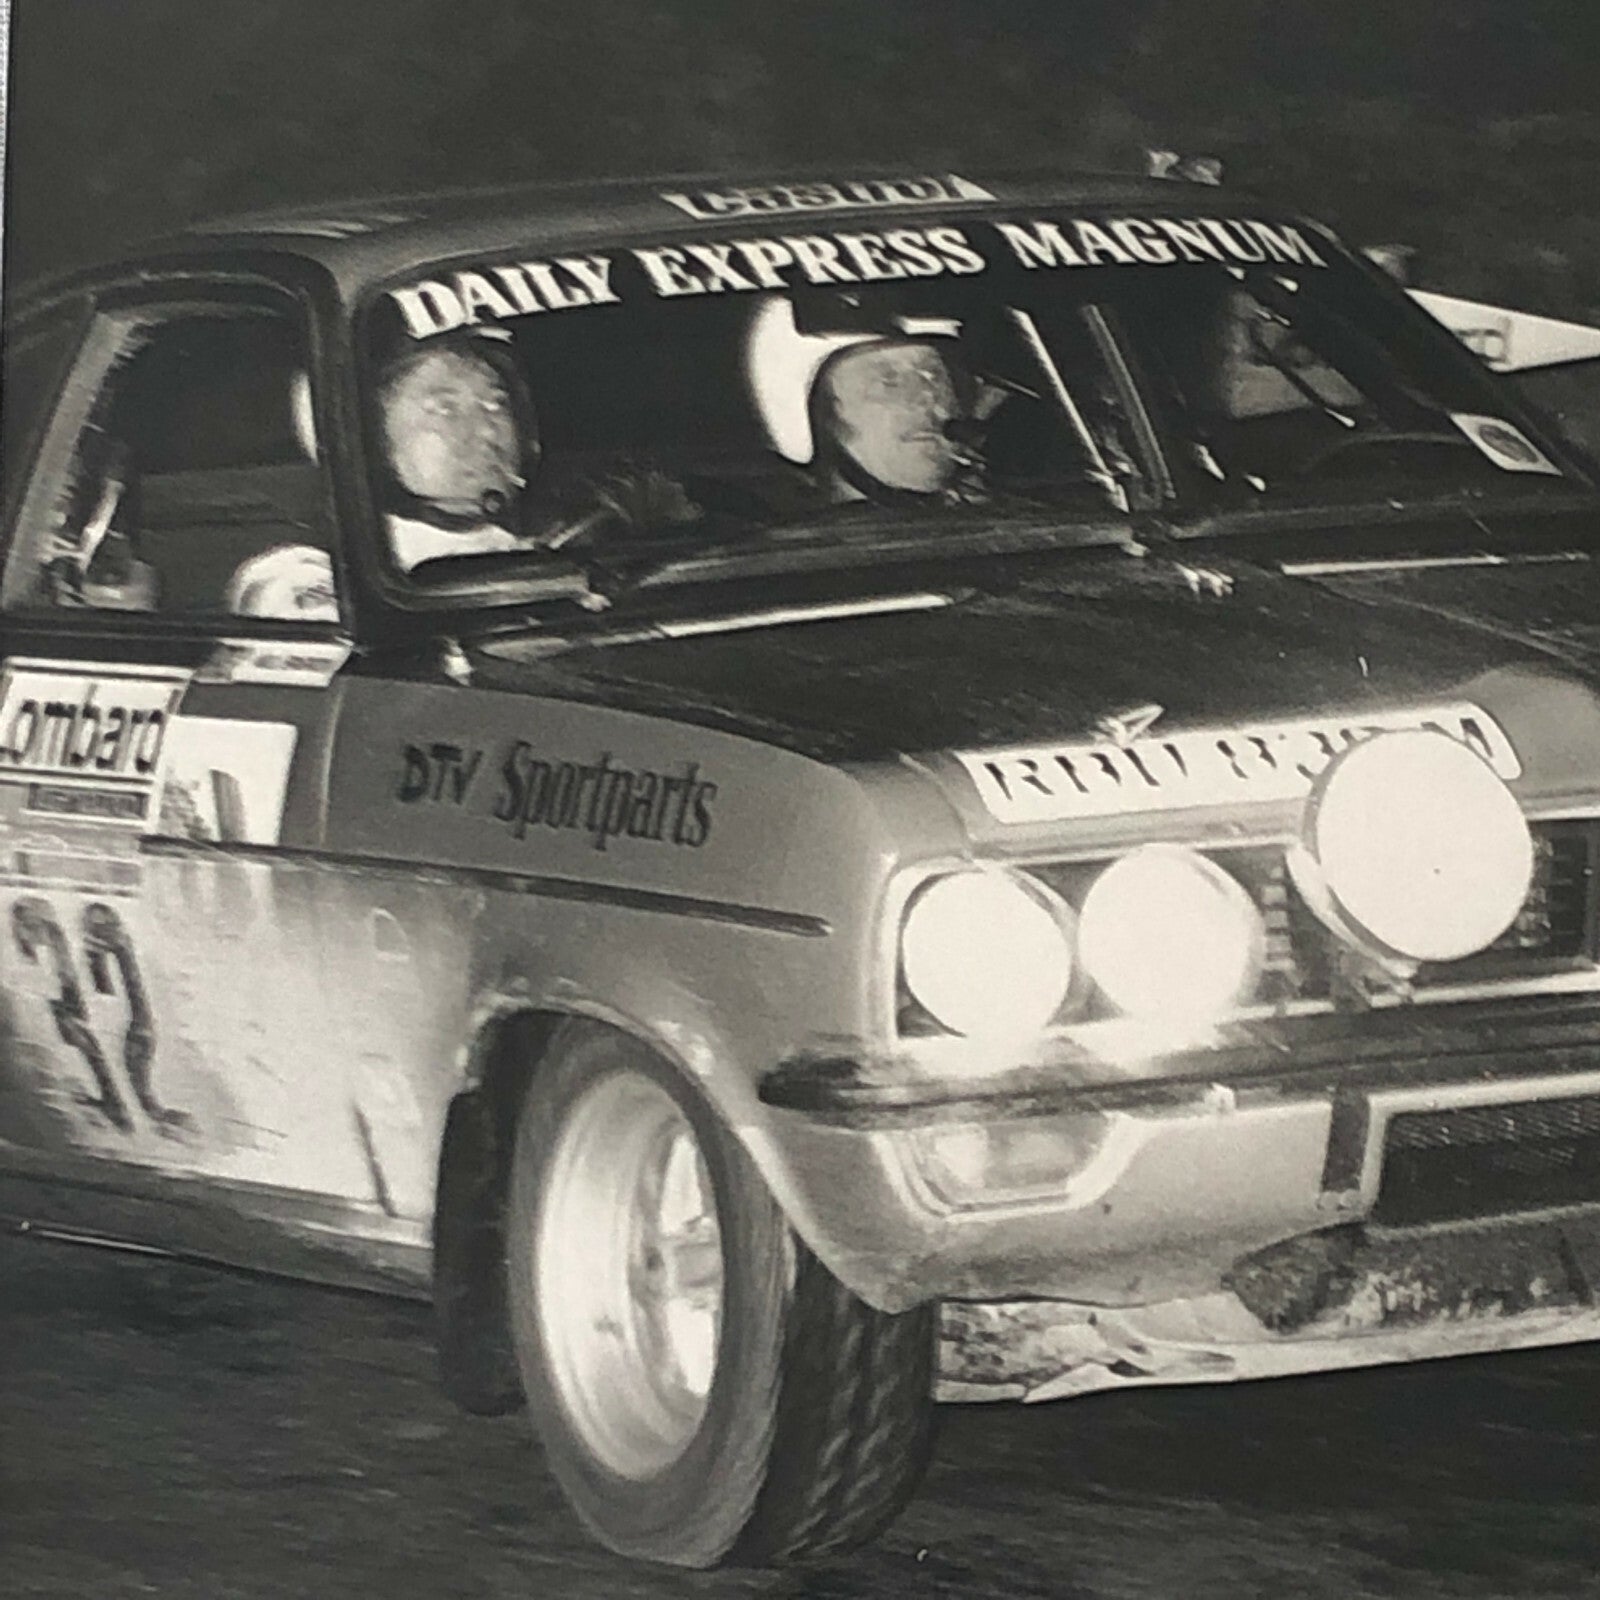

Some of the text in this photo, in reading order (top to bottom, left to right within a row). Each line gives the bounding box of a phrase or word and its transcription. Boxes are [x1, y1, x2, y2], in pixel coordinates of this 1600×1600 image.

[387, 217, 1329, 340] DAILY EXPRESS MAGNUM
[397, 740, 719, 851] DTV Sportparts
